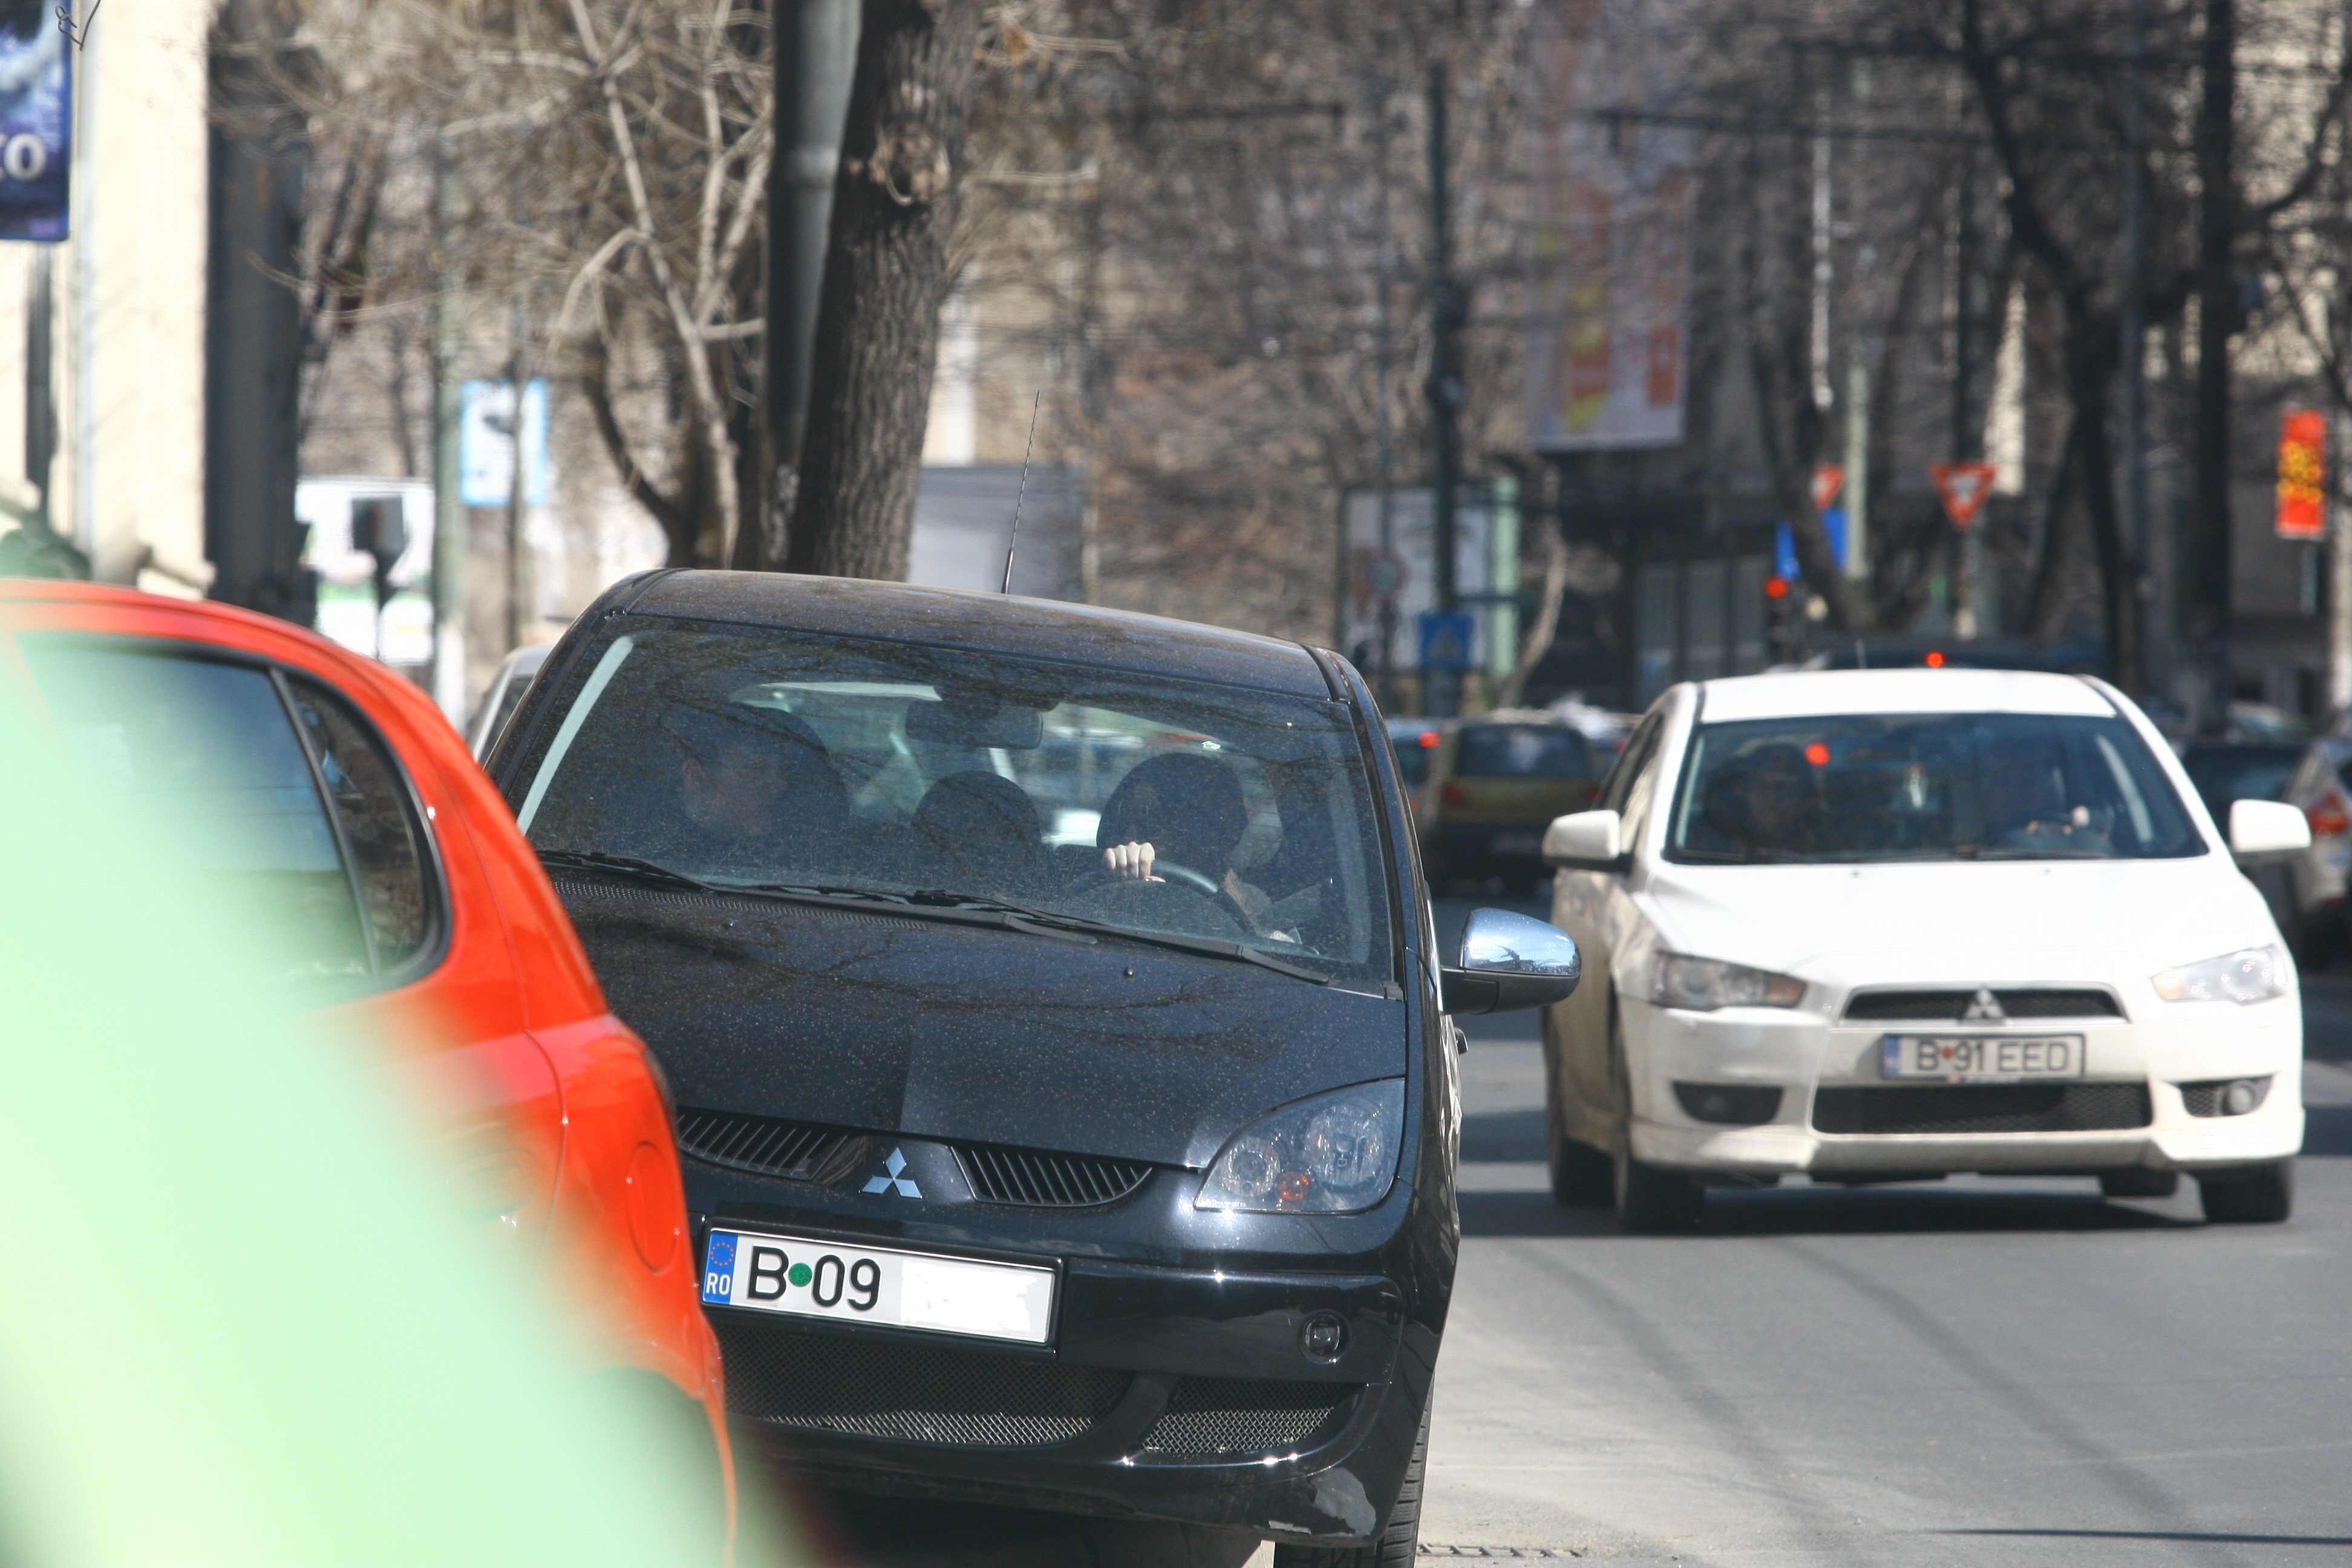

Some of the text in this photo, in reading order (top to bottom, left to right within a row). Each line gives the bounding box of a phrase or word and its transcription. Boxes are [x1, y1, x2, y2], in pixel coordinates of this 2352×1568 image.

[1916, 1039, 1939, 1071] B
[1953, 1039, 1984, 1072] 91
[705, 1271, 731, 1296] RO
[746, 1244, 882, 1312] B 09
